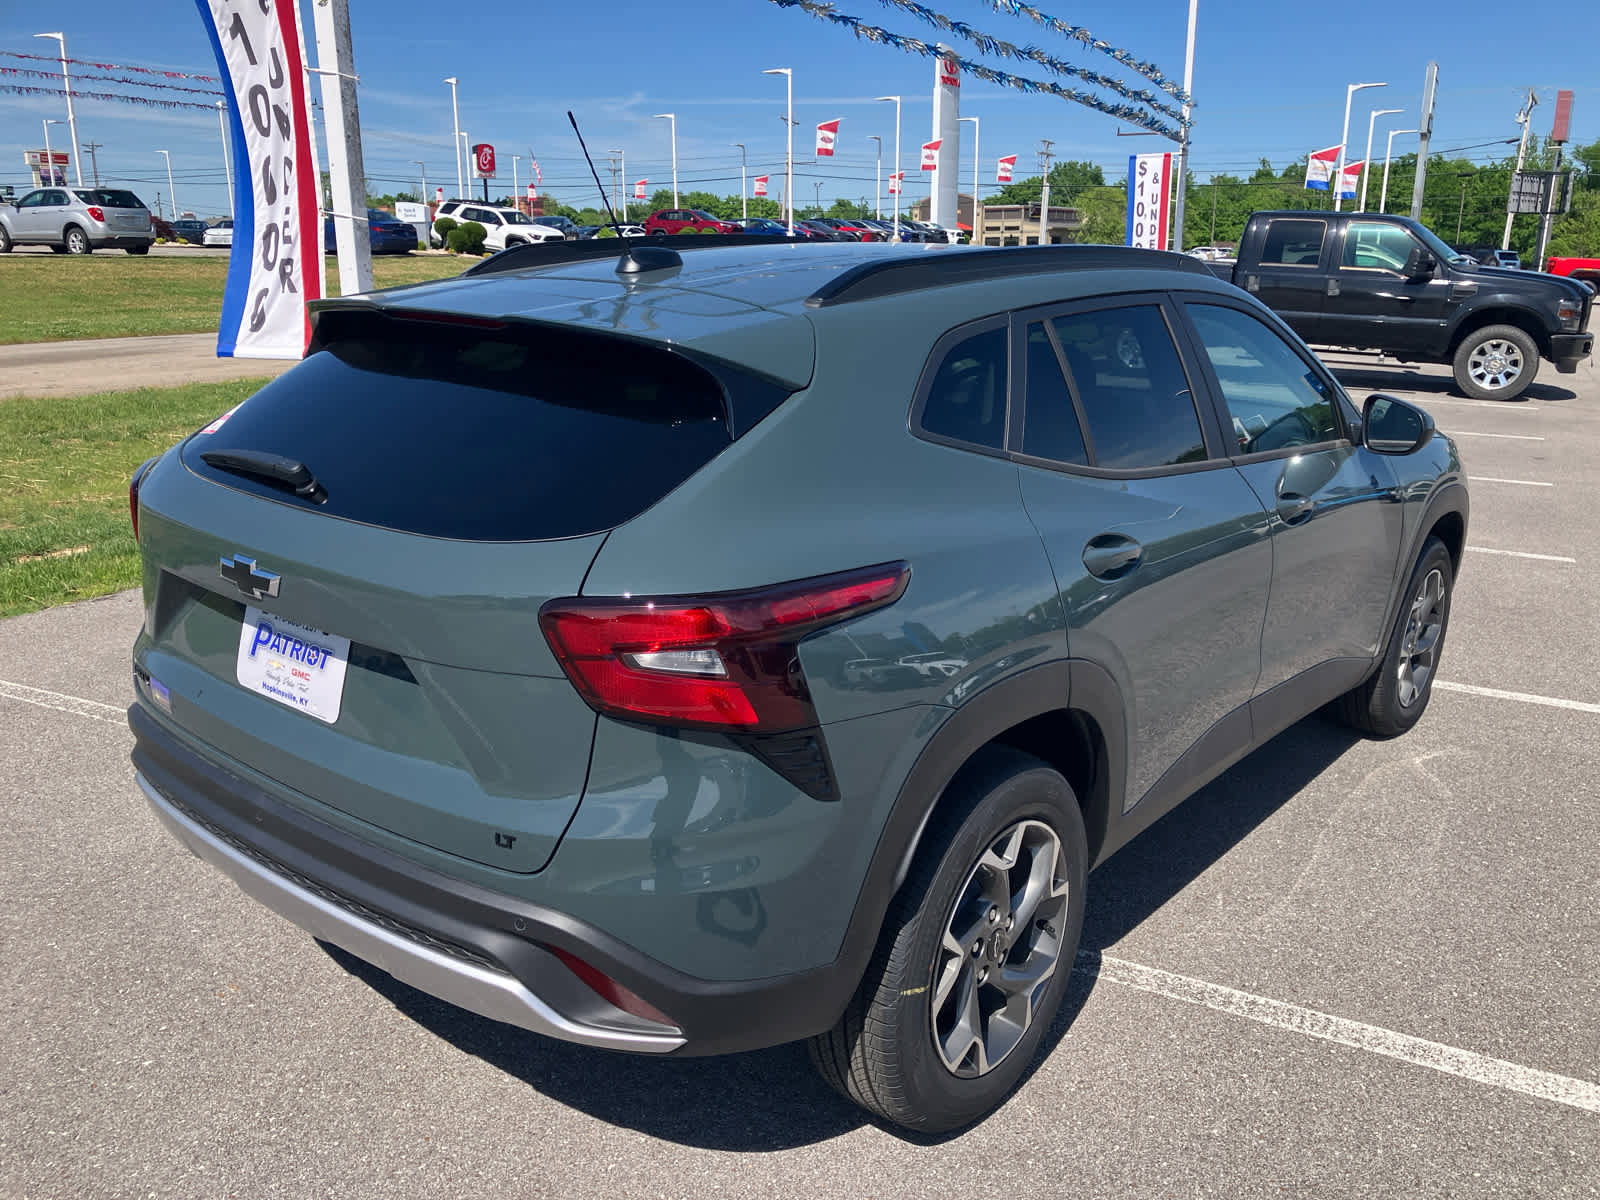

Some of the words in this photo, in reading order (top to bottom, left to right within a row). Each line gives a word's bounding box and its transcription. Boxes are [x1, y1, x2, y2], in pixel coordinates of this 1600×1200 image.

[1152, 172, 1160, 184] &
[250, 623, 333, 670] PATRIOT
[291, 667, 311, 681] GMC
[262, 681, 298, 704] Hopkinsville,
[299, 696, 309, 707] KY
[495, 832, 517, 850] LT
